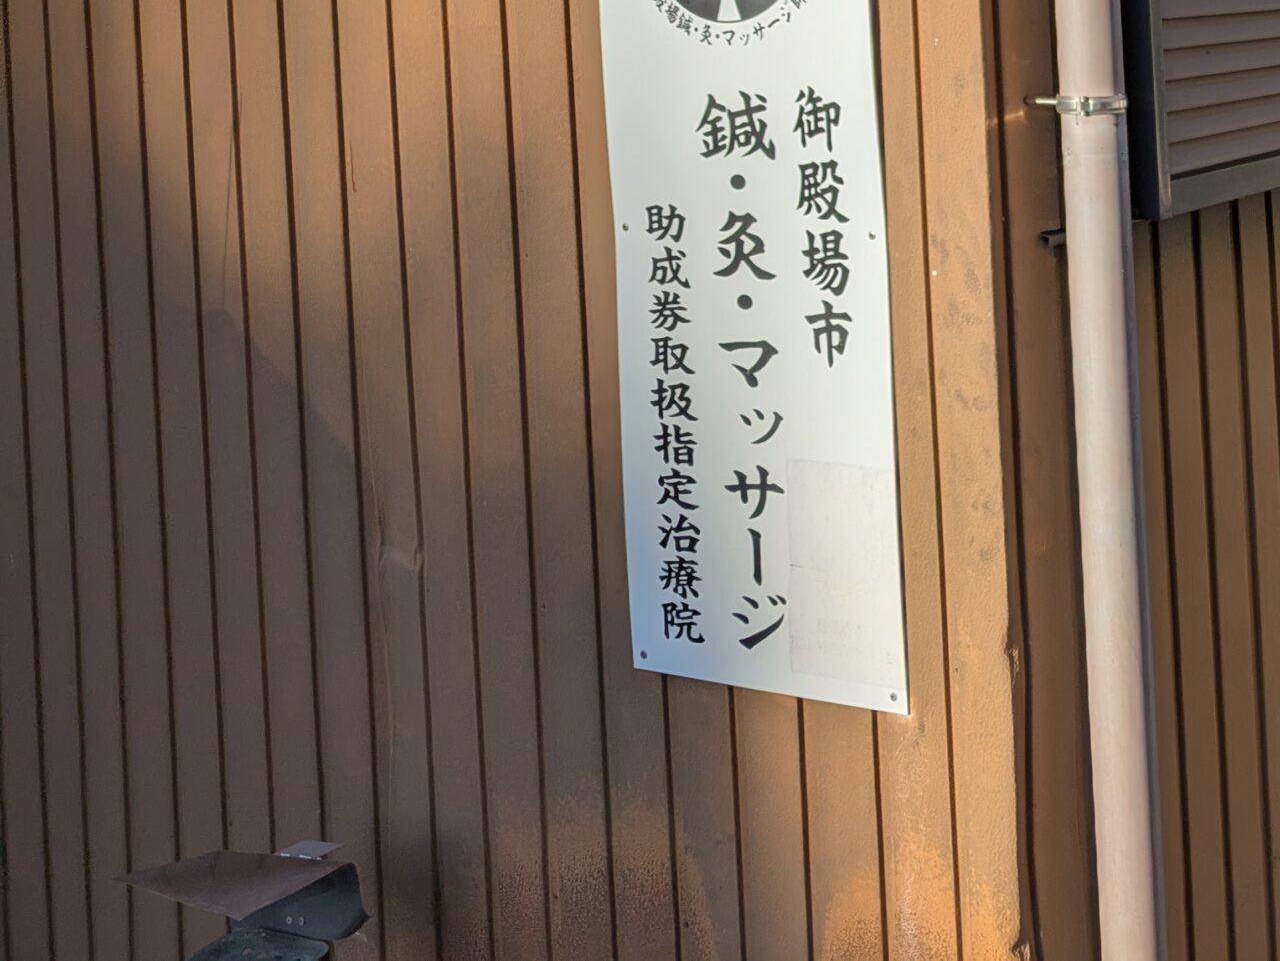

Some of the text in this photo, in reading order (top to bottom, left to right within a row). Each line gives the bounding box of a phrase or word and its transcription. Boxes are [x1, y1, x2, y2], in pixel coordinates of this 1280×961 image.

[645, 203, 705, 644] 助成券取扱指定治療院
[695, 90, 787, 650] 鍼・灸・マッサージ
[792, 85, 853, 368] 御殿場市
